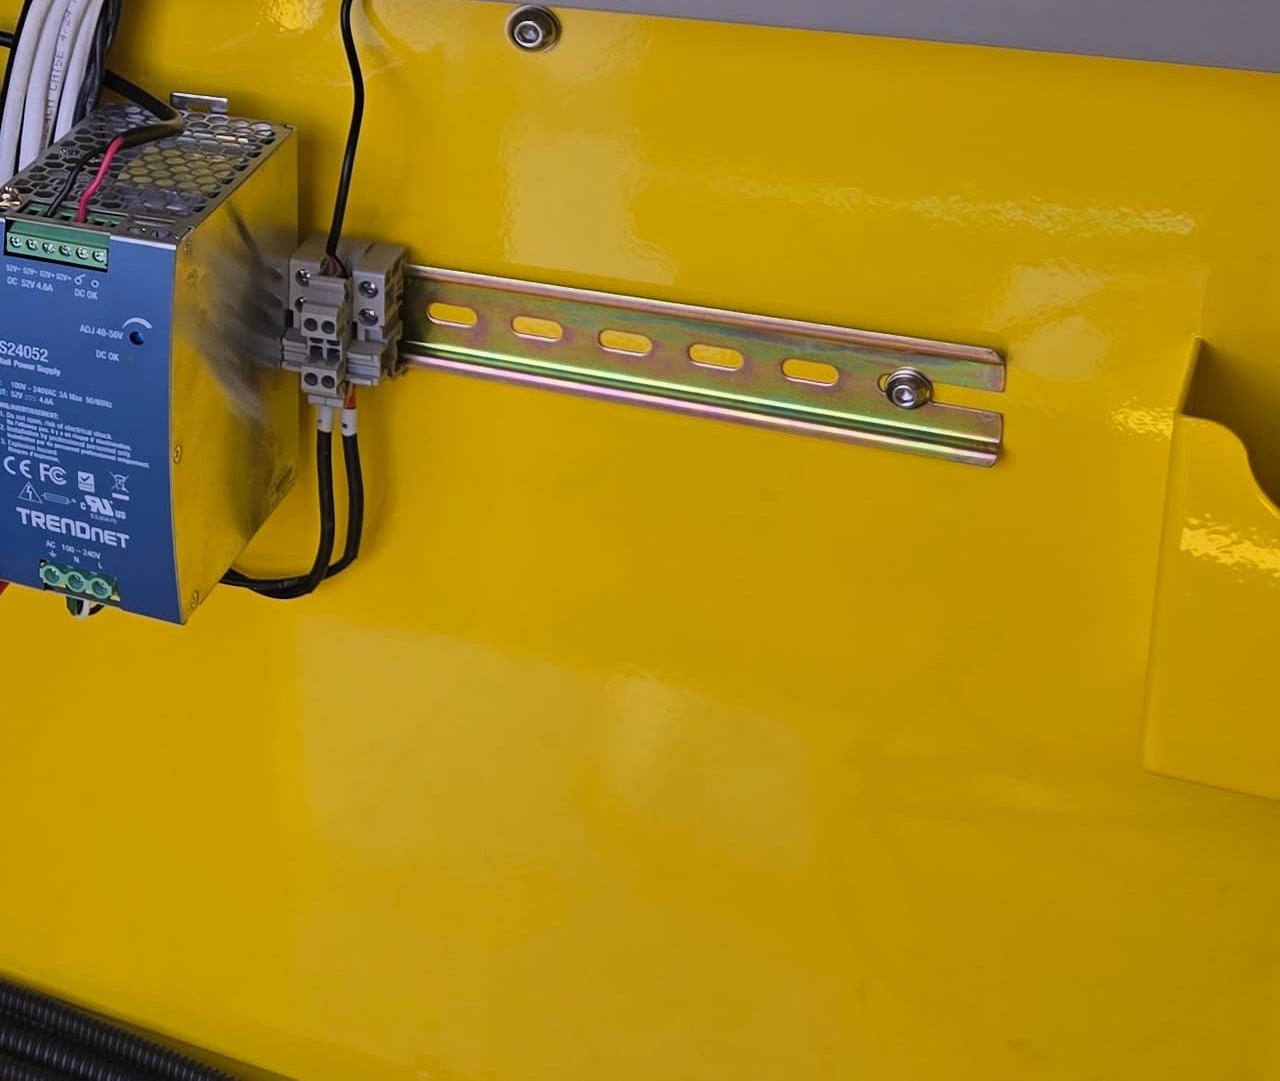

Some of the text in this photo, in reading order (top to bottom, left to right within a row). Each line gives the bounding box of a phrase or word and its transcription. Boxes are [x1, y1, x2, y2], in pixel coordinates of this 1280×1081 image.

[7, 276, 18, 286] DC
[74, 288, 85, 298] DC
[96, 349, 107, 359] DC
[14, 359, 35, 371] Power
[37, 364, 61, 377] Supply
